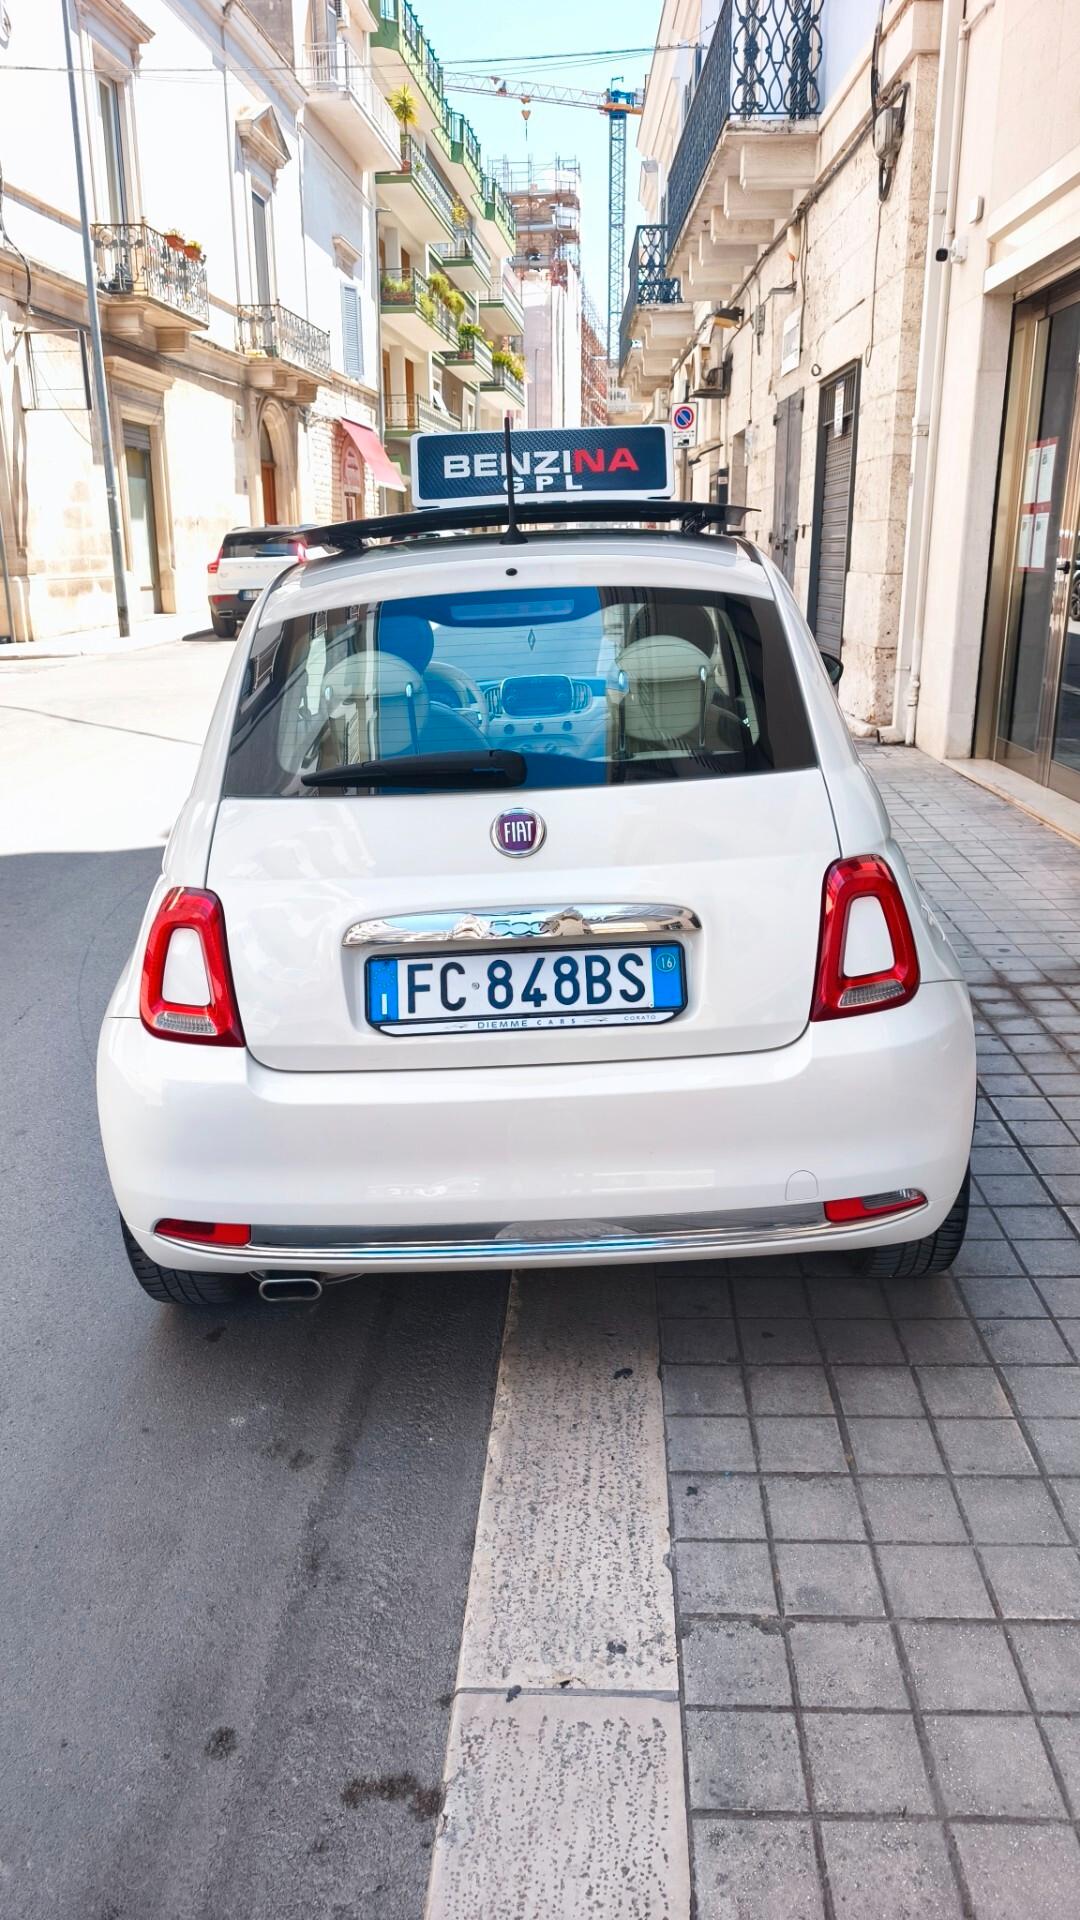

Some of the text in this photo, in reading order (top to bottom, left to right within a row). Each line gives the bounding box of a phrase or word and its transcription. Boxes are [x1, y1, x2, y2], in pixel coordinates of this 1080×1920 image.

[443, 447, 640, 479] BENZINA
[503, 474, 583, 493] GPL
[503, 820, 534, 843] FIAT
[407, 952, 646, 1014] FC 848BS
[477, 1014, 657, 1029] DIEMME CARS CORATO
